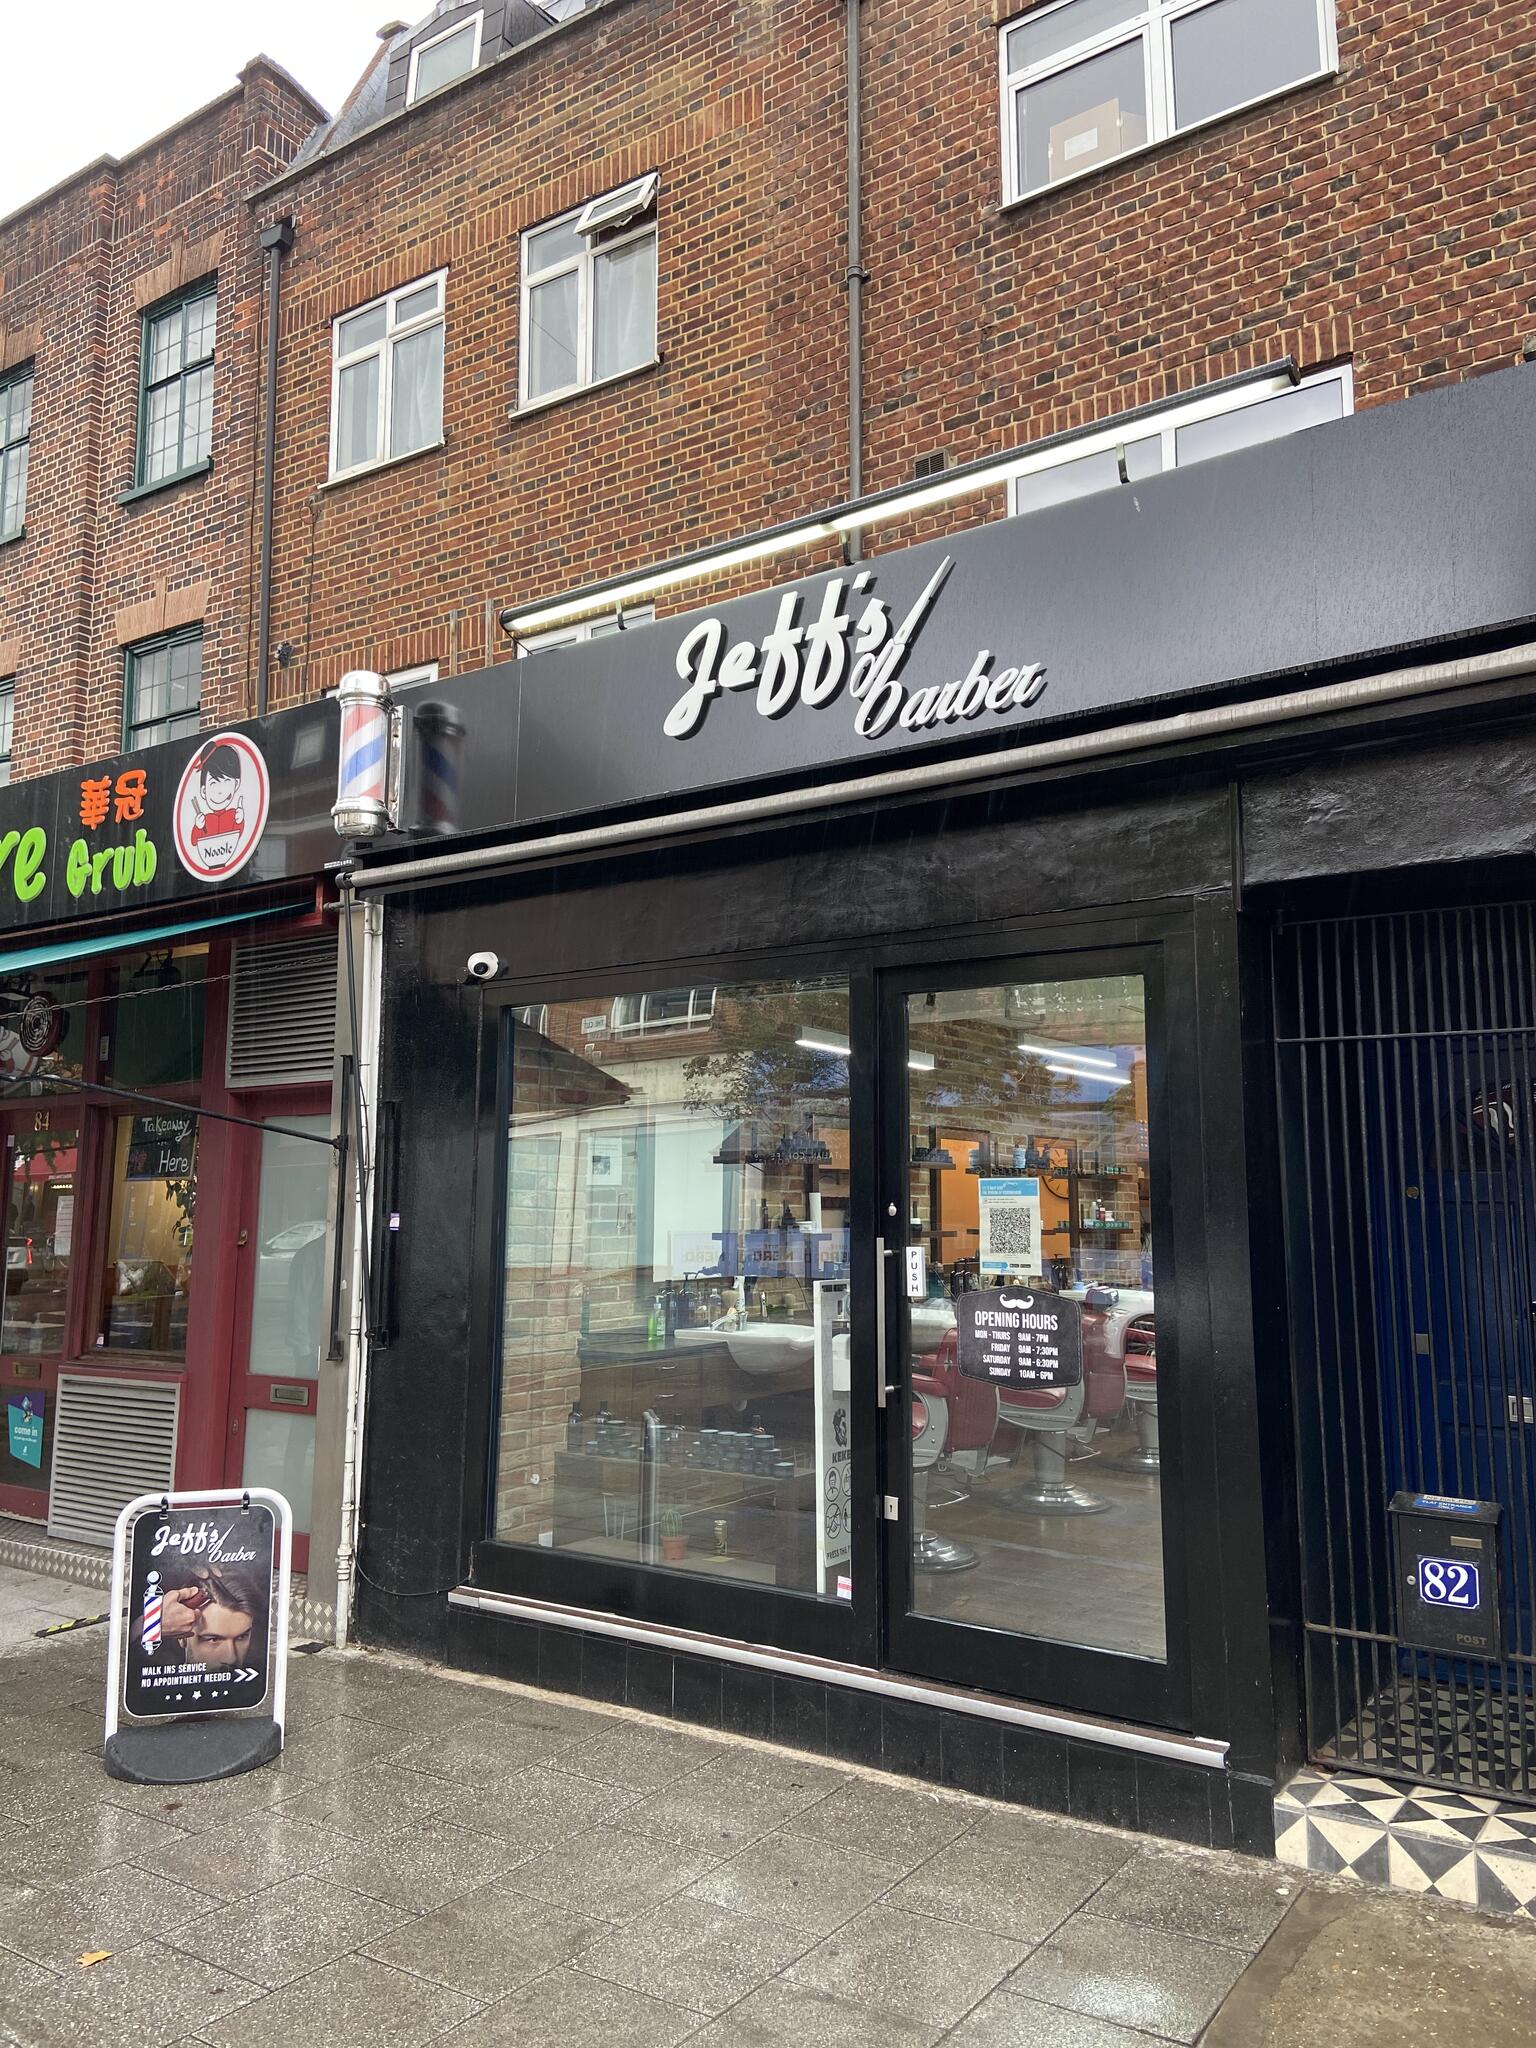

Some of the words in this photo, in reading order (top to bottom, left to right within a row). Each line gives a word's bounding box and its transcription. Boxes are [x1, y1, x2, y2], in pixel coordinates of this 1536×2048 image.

[663, 571, 888, 738] Jeff's
[850, 628, 1042, 737] Barber
[79, 769, 148, 830] 華冠
[66, 828, 158, 898] Grub
[34, 1112, 50, 1131] 84
[159, 1149, 189, 1173] Here
[911, 1251, 919, 1292] PUSH
[975, 1311, 1019, 1328] OPENING
[1022, 1313, 1058, 1331] HOURS
[975, 1330, 987, 1339] MON
[992, 1331, 1010, 1340] THURS
[1018, 1332, 1031, 1341] 9AM
[1036, 1334, 1049, 1343] 7PM
[991, 1343, 1010, 1352] FRIDAY
[1018, 1345, 1031, 1354] 9AM
[1036, 1346, 1058, 1356] 7:30PM
[983, 1355, 1011, 1364] SATURDAY
[1019, 1357, 1031, 1366] 9AM
[989, 1367, 1011, 1377] SUNDAY
[1019, 1370, 1035, 1379] 10AM
[1040, 1371, 1053, 1380] 6PM
[14, 1426, 31, 1436] come
[32, 1426, 37, 1437] in
[150, 1521, 219, 1556] Jeff's
[1424, 1562, 1469, 1604] 82
[1456, 1633, 1488, 1645] POST
[142, 1666, 161, 1676] WALK
[164, 1665, 176, 1674] INS
[178, 1663, 207, 1673] SERVICE
[141, 1679, 151, 1687] NO
[153, 1675, 202, 1687] APPOINTMENT
[204, 1672, 231, 1682] NEEDED
